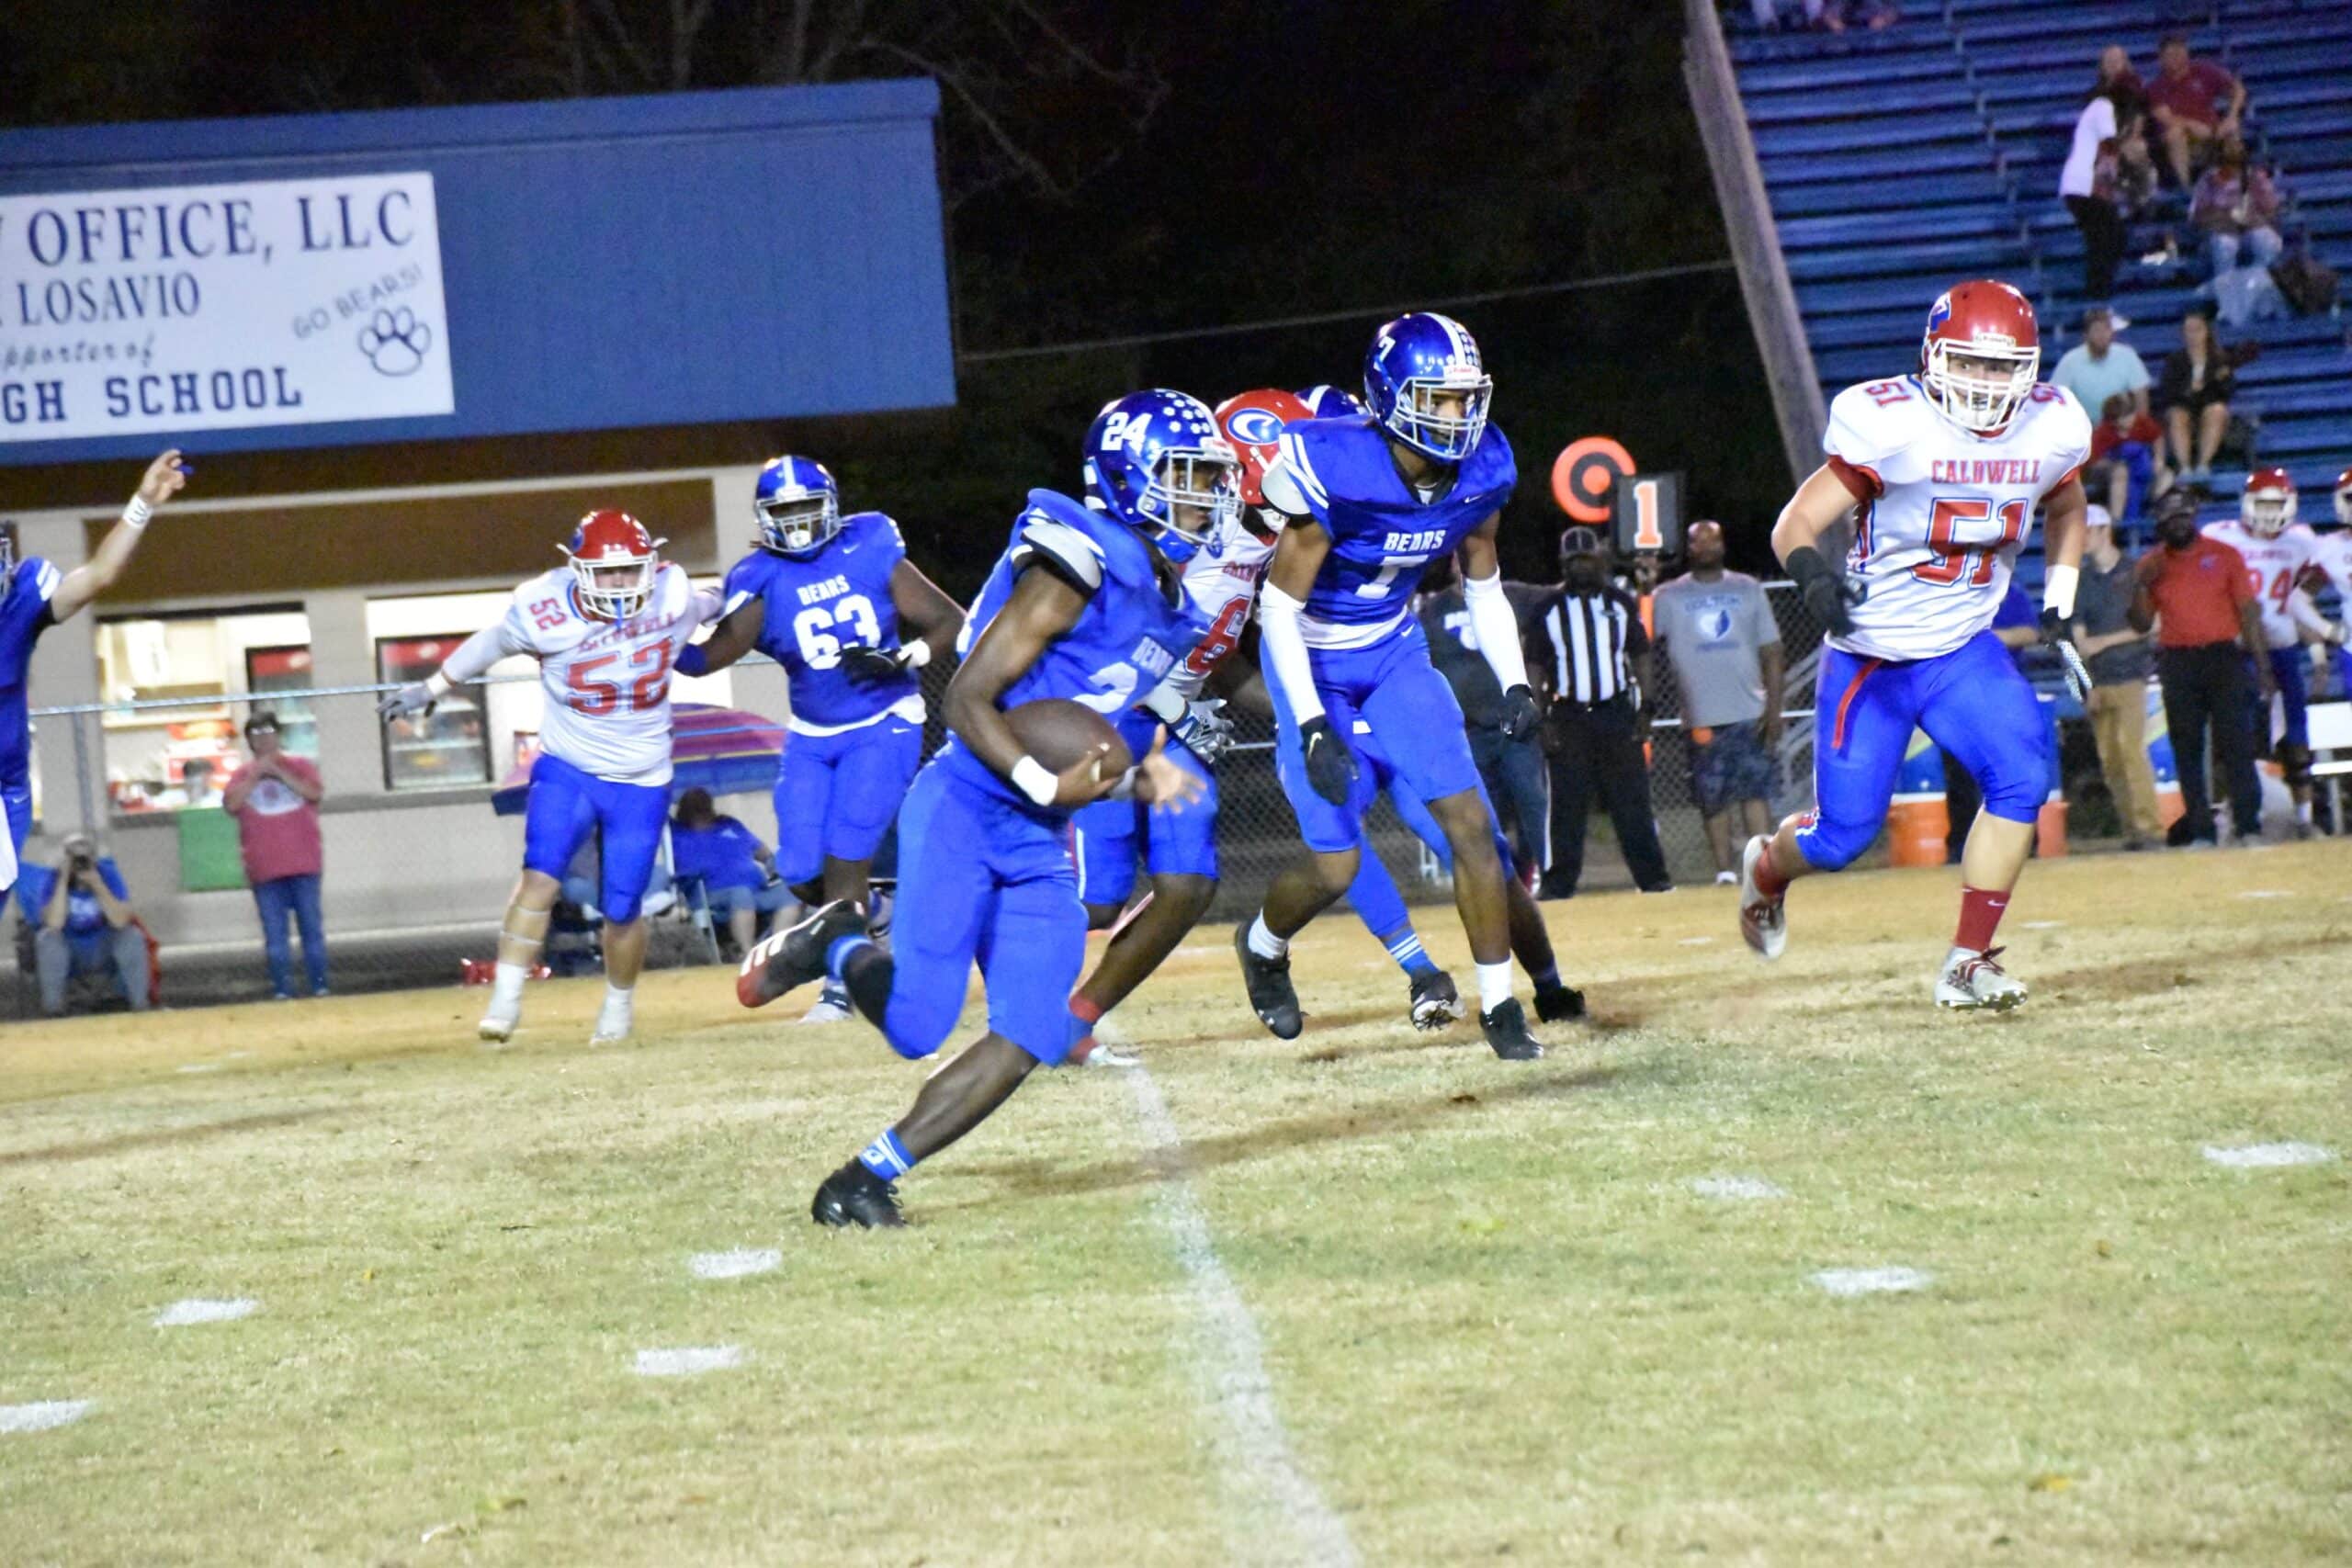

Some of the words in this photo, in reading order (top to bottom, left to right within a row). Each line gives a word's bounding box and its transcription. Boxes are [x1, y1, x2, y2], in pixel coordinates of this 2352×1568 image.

[28, 198, 274, 267] OFFICE,
[298, 189, 413, 254] LLC
[17, 271, 200, 326] LOSAVIO
[293, 308, 331, 339] GO
[1378, 335, 1396, 363] 7
[2, 380, 67, 424] GH
[106, 367, 302, 417] SCHOOL
[1865, 381, 1912, 407] 51
[1101, 412, 1153, 457] 24
[1931, 459, 2041, 484] CALDWELL
[1634, 480, 1663, 548] 1
[1383, 529, 1446, 552] BEARS
[1911, 498, 2029, 589] 51
[797, 574, 851, 606] BEARS
[529, 597, 567, 631] 52
[793, 594, 881, 670] 63
[565, 636, 678, 716] 52
